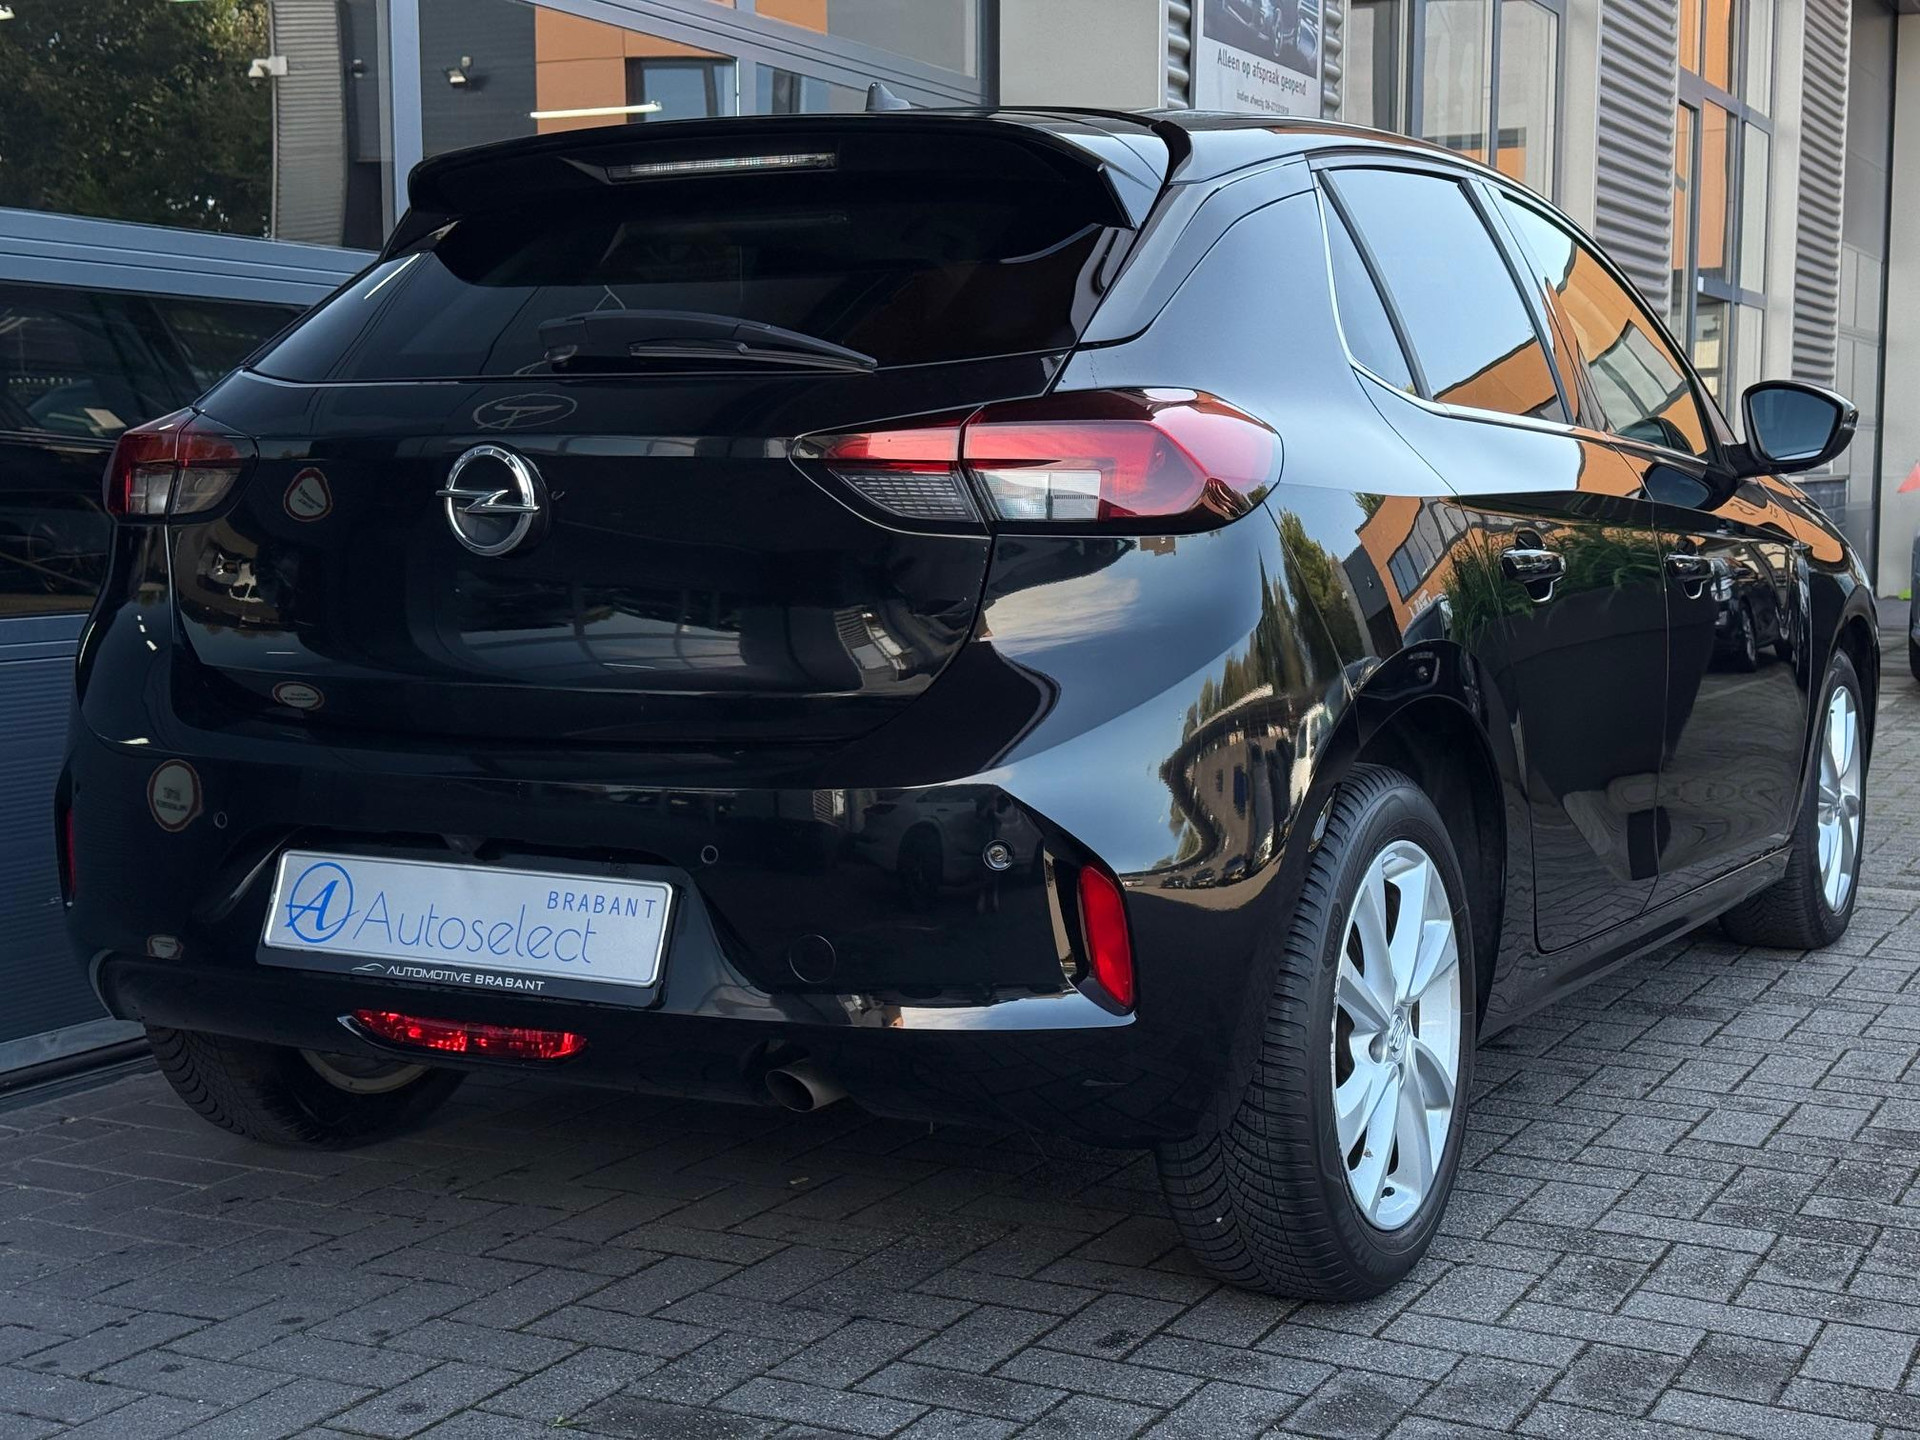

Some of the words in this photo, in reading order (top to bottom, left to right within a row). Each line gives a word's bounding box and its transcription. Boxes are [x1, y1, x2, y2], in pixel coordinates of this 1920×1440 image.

[1217, 47, 1240, 72] Alleen
[1242, 60, 1251, 79] op
[1252, 61, 1279, 85] afspraak
[1281, 75, 1307, 96] geopend
[547, 890, 657, 918] BRABANT
[352, 890, 598, 964] Autoselect
[387, 966, 471, 983] AUTOMOTIVE
[474, 974, 545, 991] BRABANT
